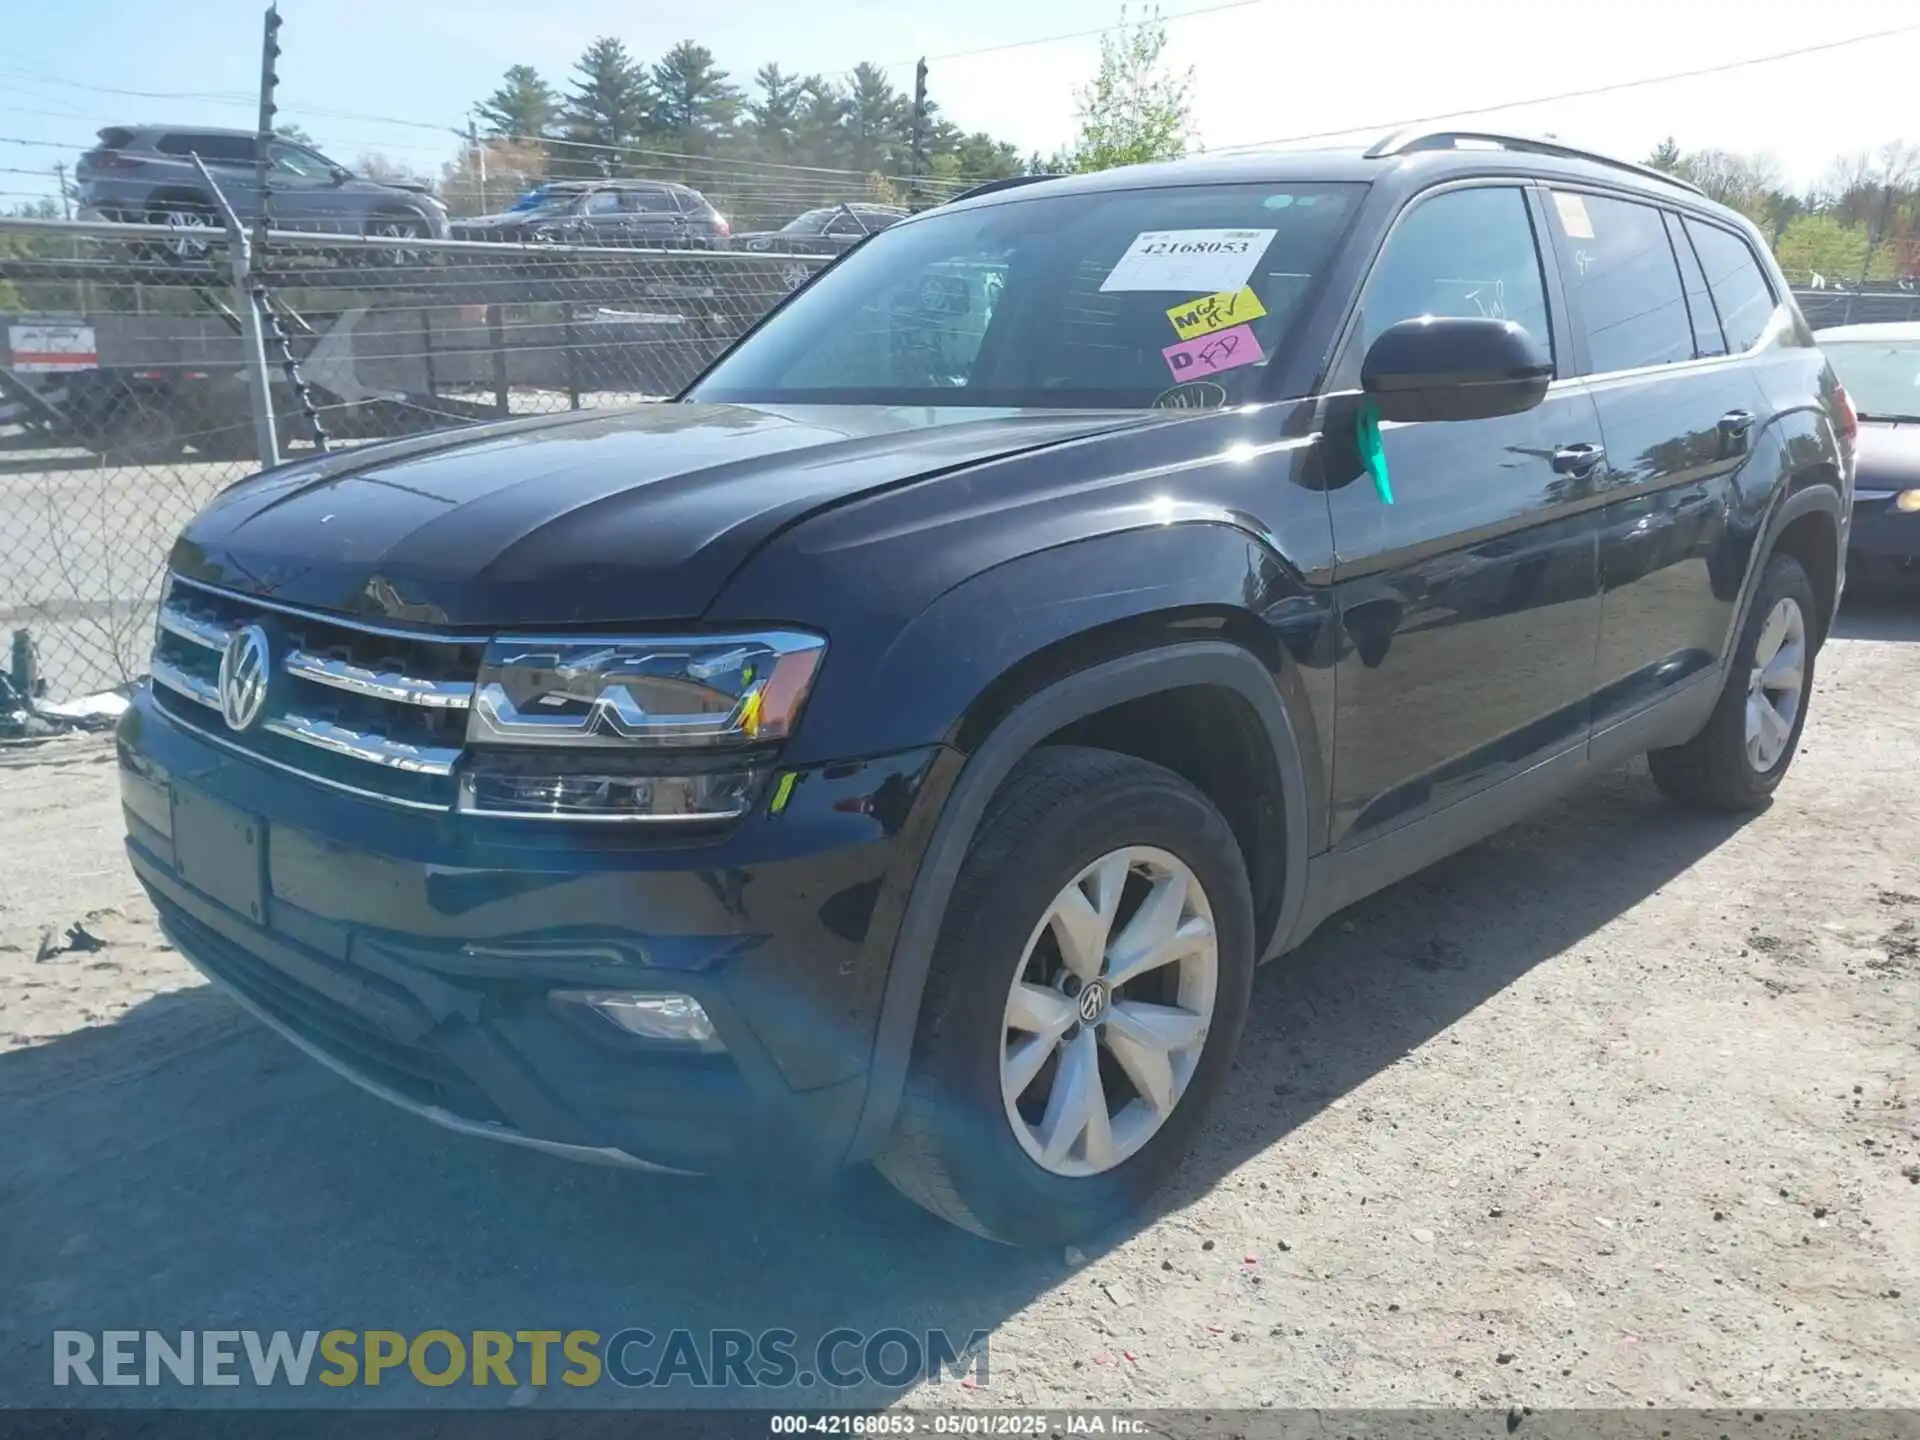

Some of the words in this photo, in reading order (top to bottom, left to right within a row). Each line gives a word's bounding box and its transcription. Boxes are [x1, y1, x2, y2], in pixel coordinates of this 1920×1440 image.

[1140, 241, 1249, 255] 42168053
[1174, 311, 1201, 329] M
[1170, 352, 1194, 370] D
